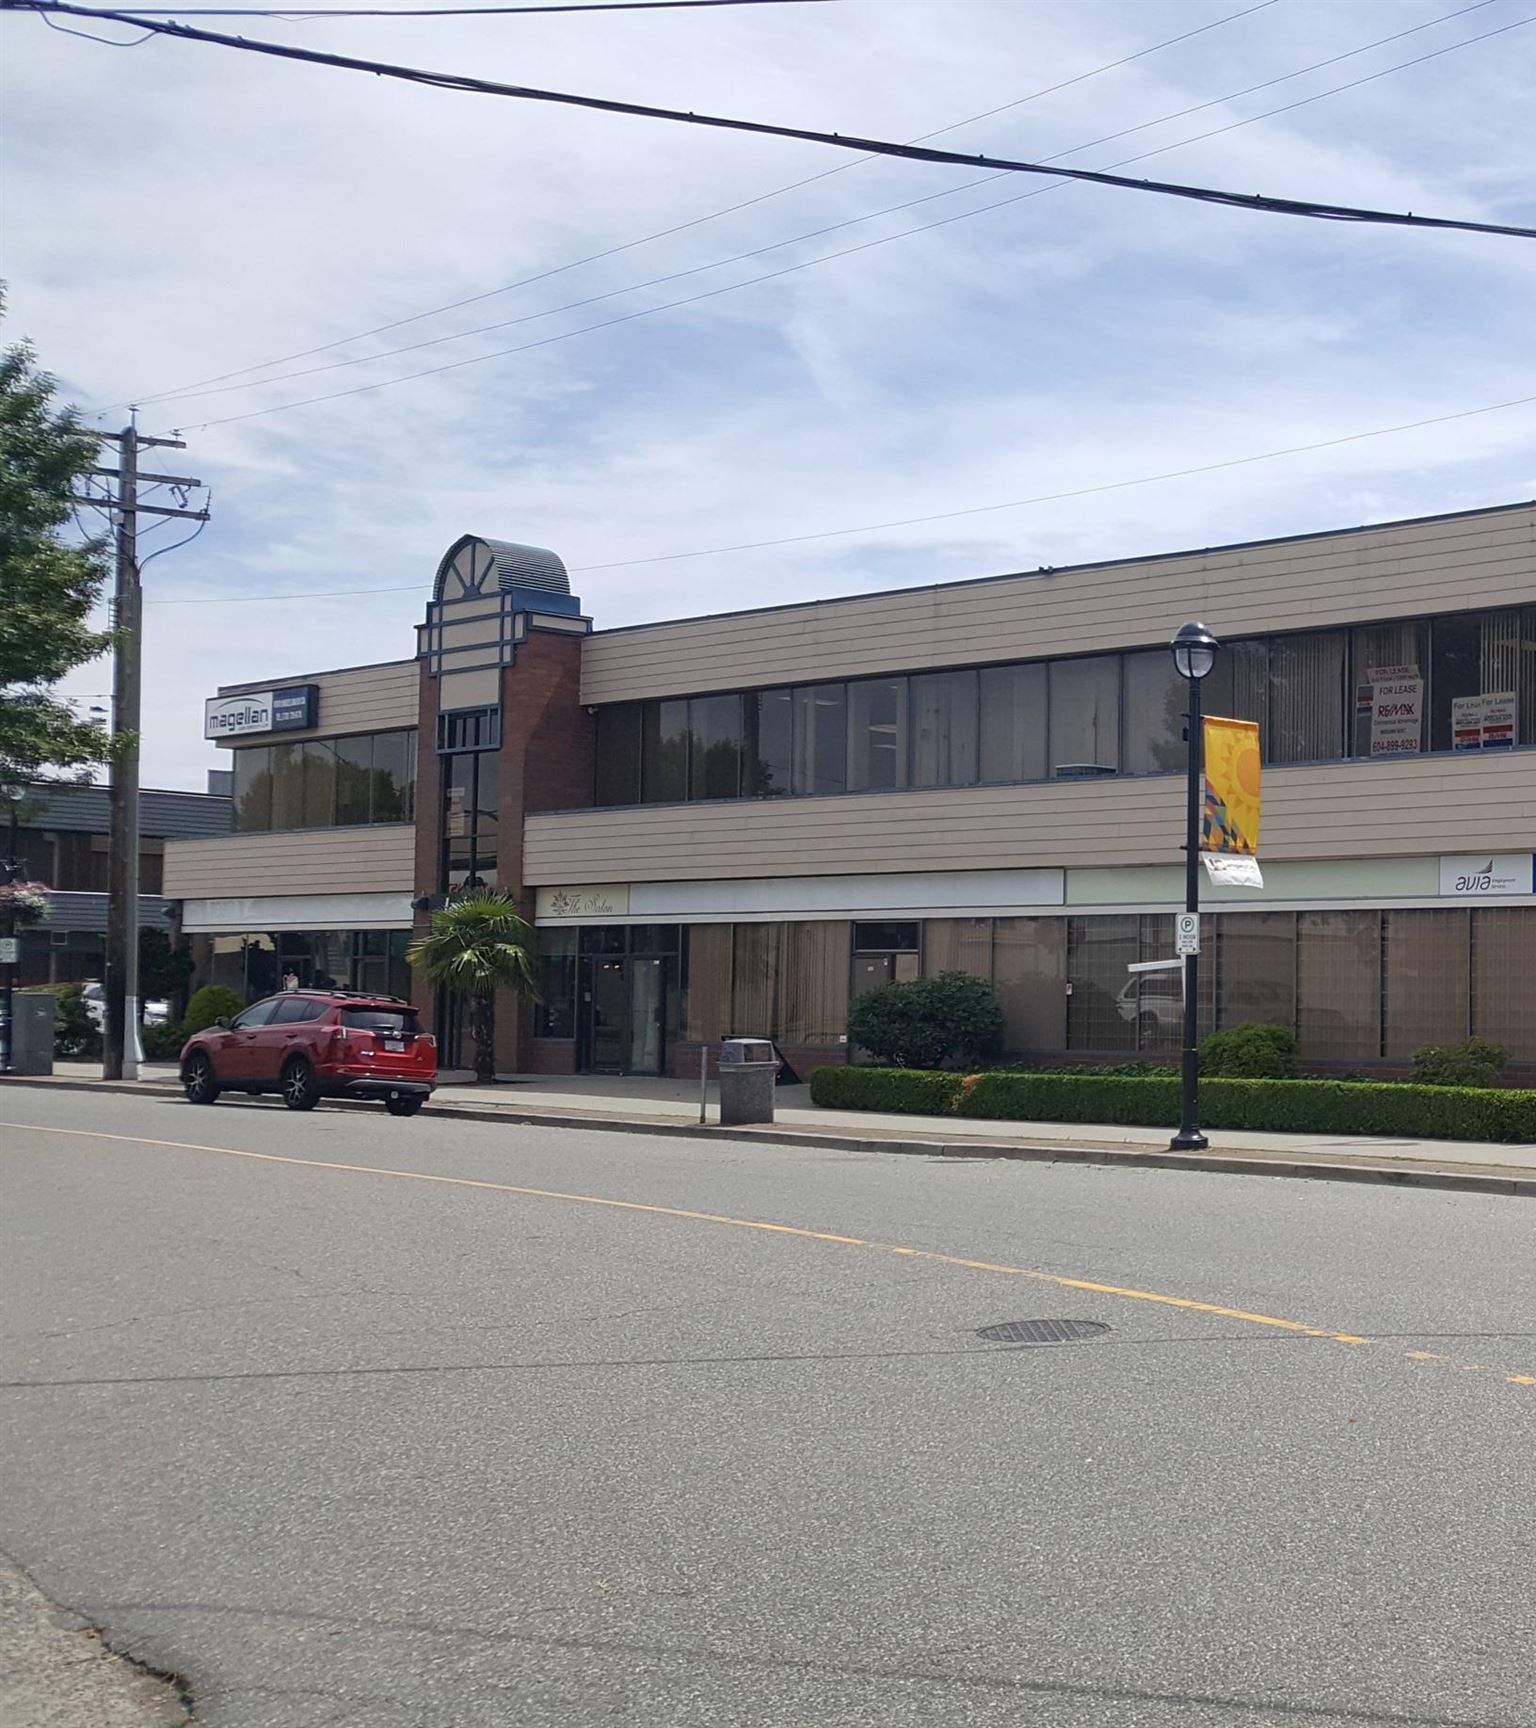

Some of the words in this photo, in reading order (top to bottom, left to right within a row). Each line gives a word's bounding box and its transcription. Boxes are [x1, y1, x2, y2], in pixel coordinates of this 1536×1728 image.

[1380, 687, 1393, 696] FOR
[1395, 684, 1417, 695] LEASE
[210, 707, 268, 731] magellan
[1455, 875, 1492, 891] avia
[568, 894, 582, 913] The
